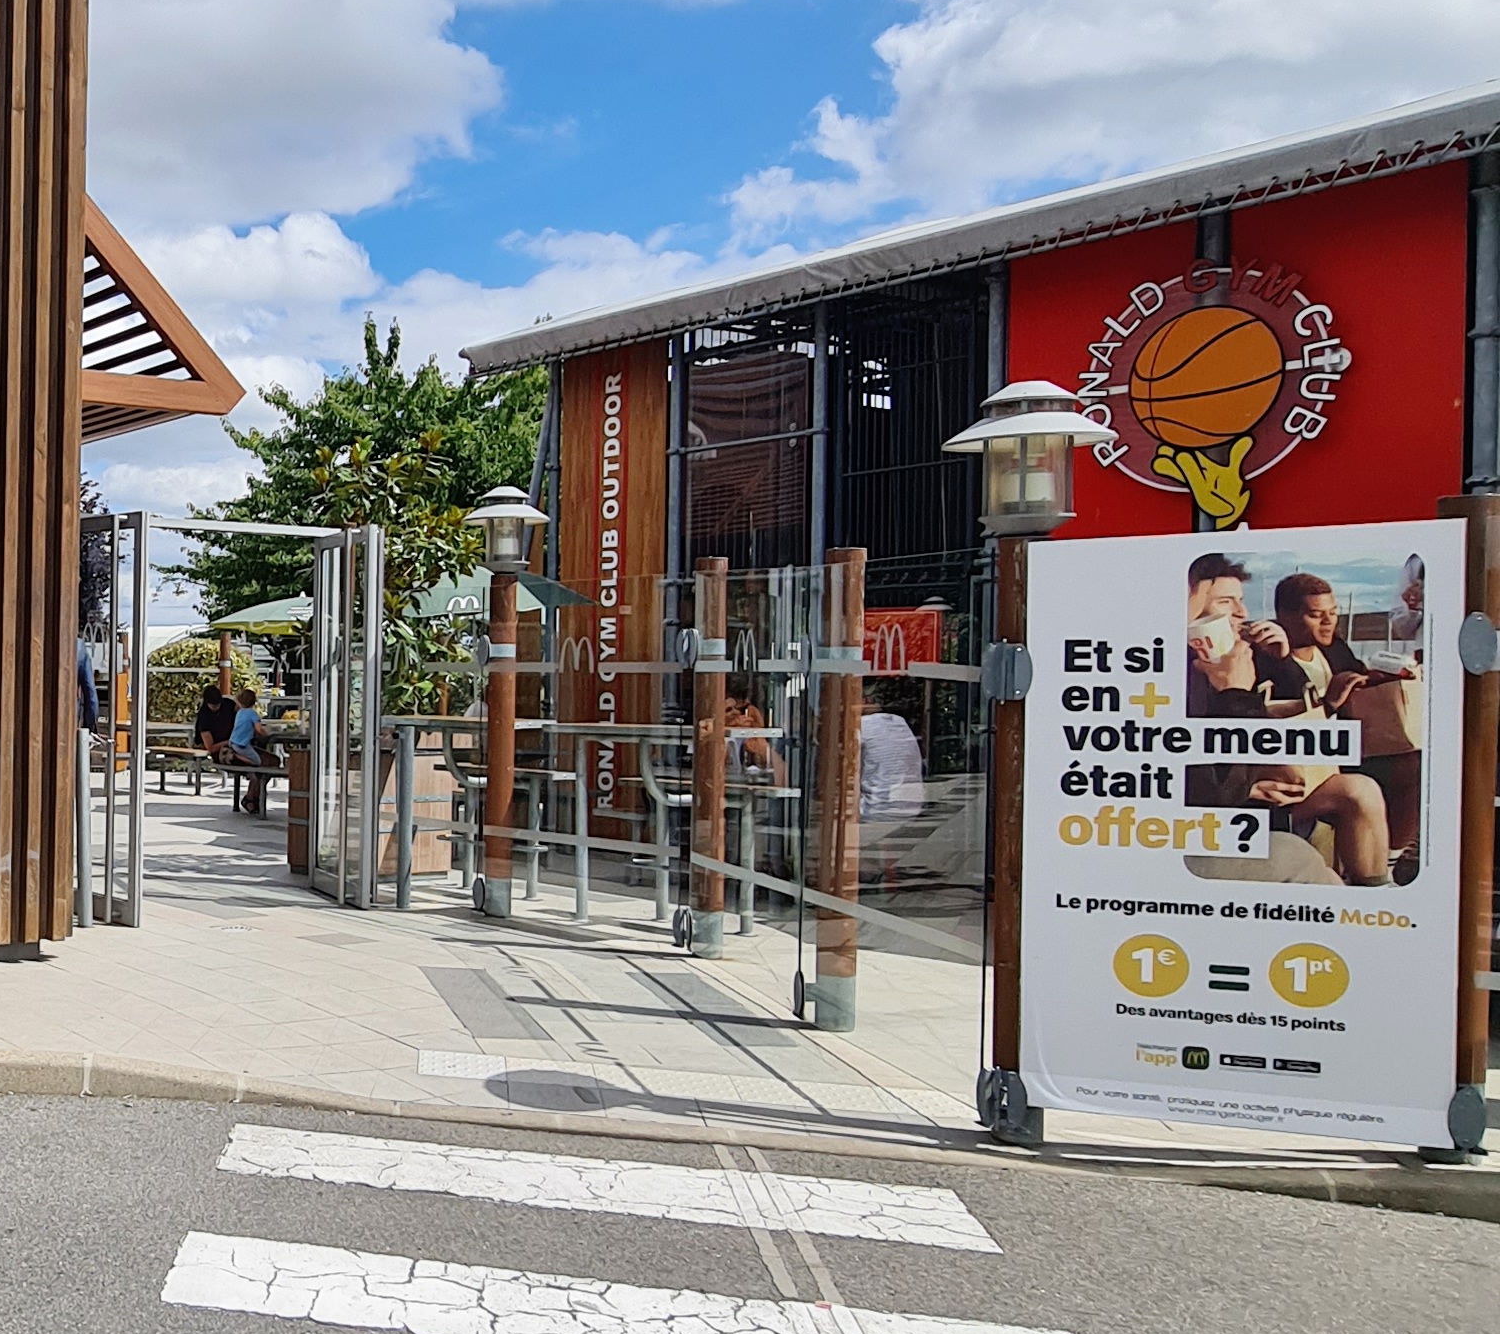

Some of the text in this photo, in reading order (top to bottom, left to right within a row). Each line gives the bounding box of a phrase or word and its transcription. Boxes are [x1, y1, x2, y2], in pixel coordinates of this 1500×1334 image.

[1077, 254, 1342, 469] RONALD GYM CLUB
[601, 371, 623, 521] OUTDOOR
[600, 528, 619, 608] CLUB
[1063, 637, 1164, 673] Et si
[1061, 685, 1120, 713] en
[1063, 720, 1350, 757] votre menu
[1060, 760, 1173, 800] était
[1058, 805, 1260, 853] offert ?
[1055, 893, 1417, 930] Le programme de fidélité McDo.
[1116, 1003, 1346, 1033] Des avantages dès 15 points
